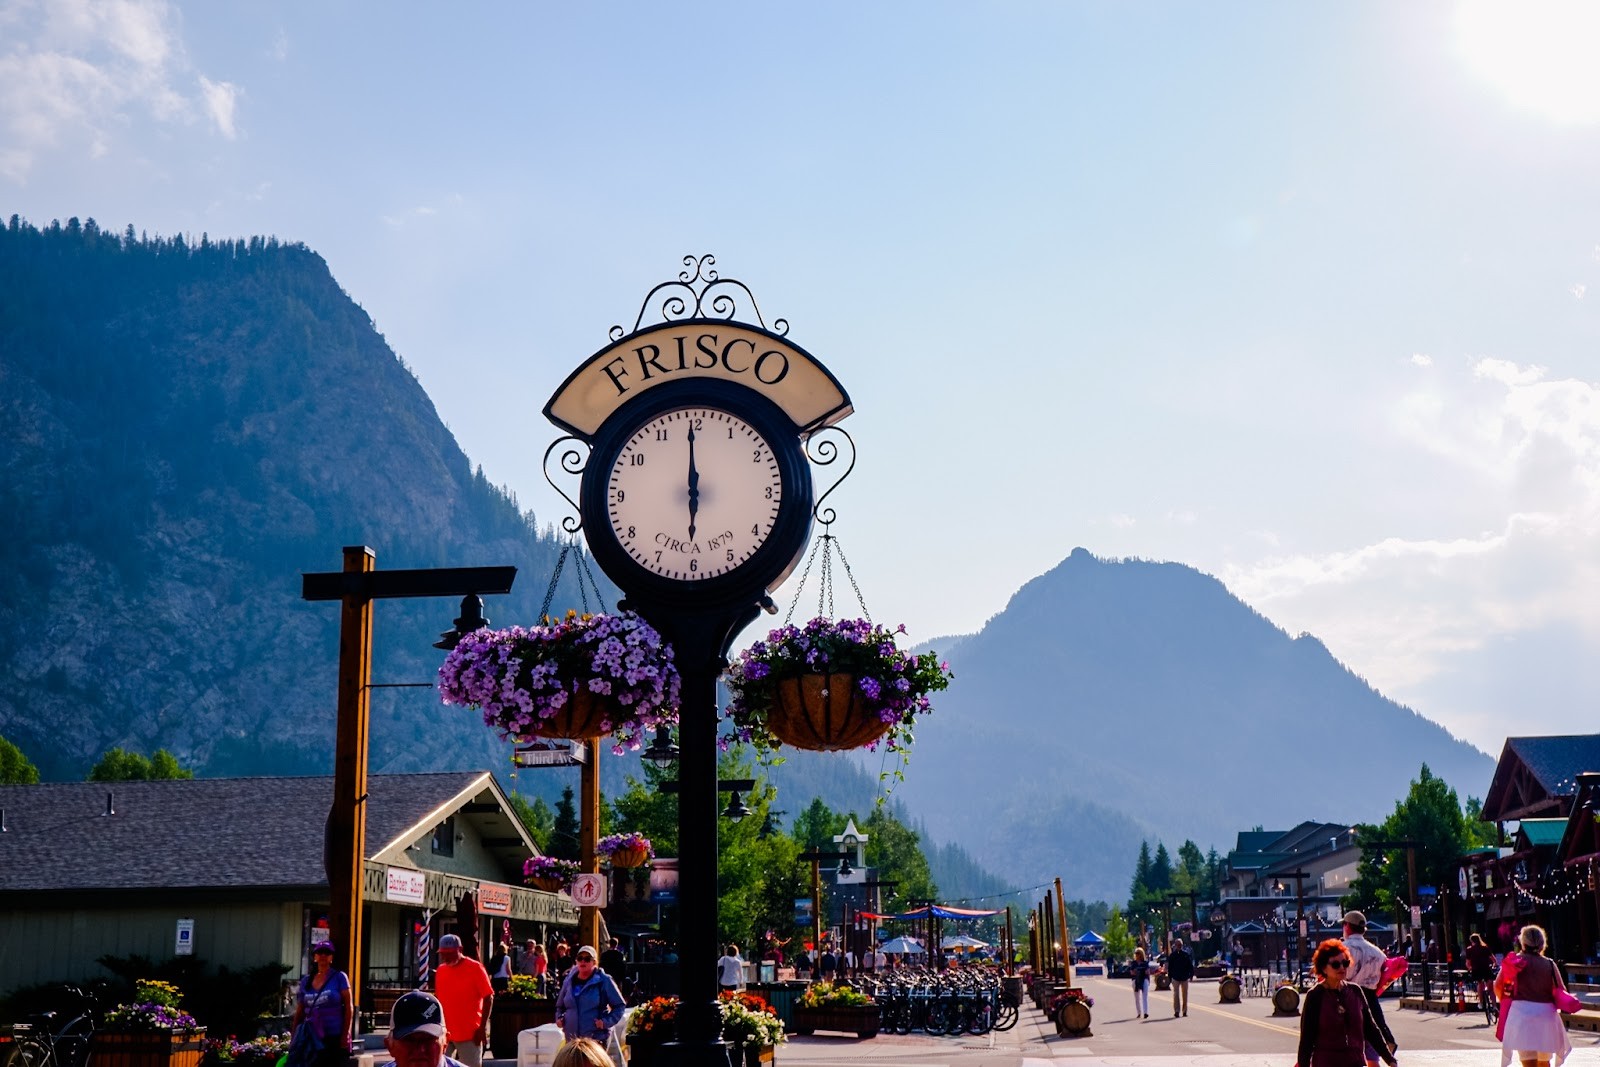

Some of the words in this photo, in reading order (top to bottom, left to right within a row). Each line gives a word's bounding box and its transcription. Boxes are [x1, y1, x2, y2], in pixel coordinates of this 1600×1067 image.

[600, 334, 789, 397] FRISCO
[688, 419, 702, 431] 12
[656, 429, 668, 441] 11
[728, 427, 733, 439] 1
[630, 453, 644, 466] 10
[753, 450, 761, 463] 2
[617, 490, 625, 503] 9
[765, 487, 772, 499] 3
[628, 526, 636, 539] 8
[751, 523, 759, 536] 4
[655, 532, 701, 554] CIRCA
[707, 530, 734, 551] 1879
[655, 550, 663, 563] 7
[726, 549, 734, 561] 5
[690, 558, 698, 571] 6
[526, 752, 554, 765] Third
[557, 753, 574, 764] Ave
